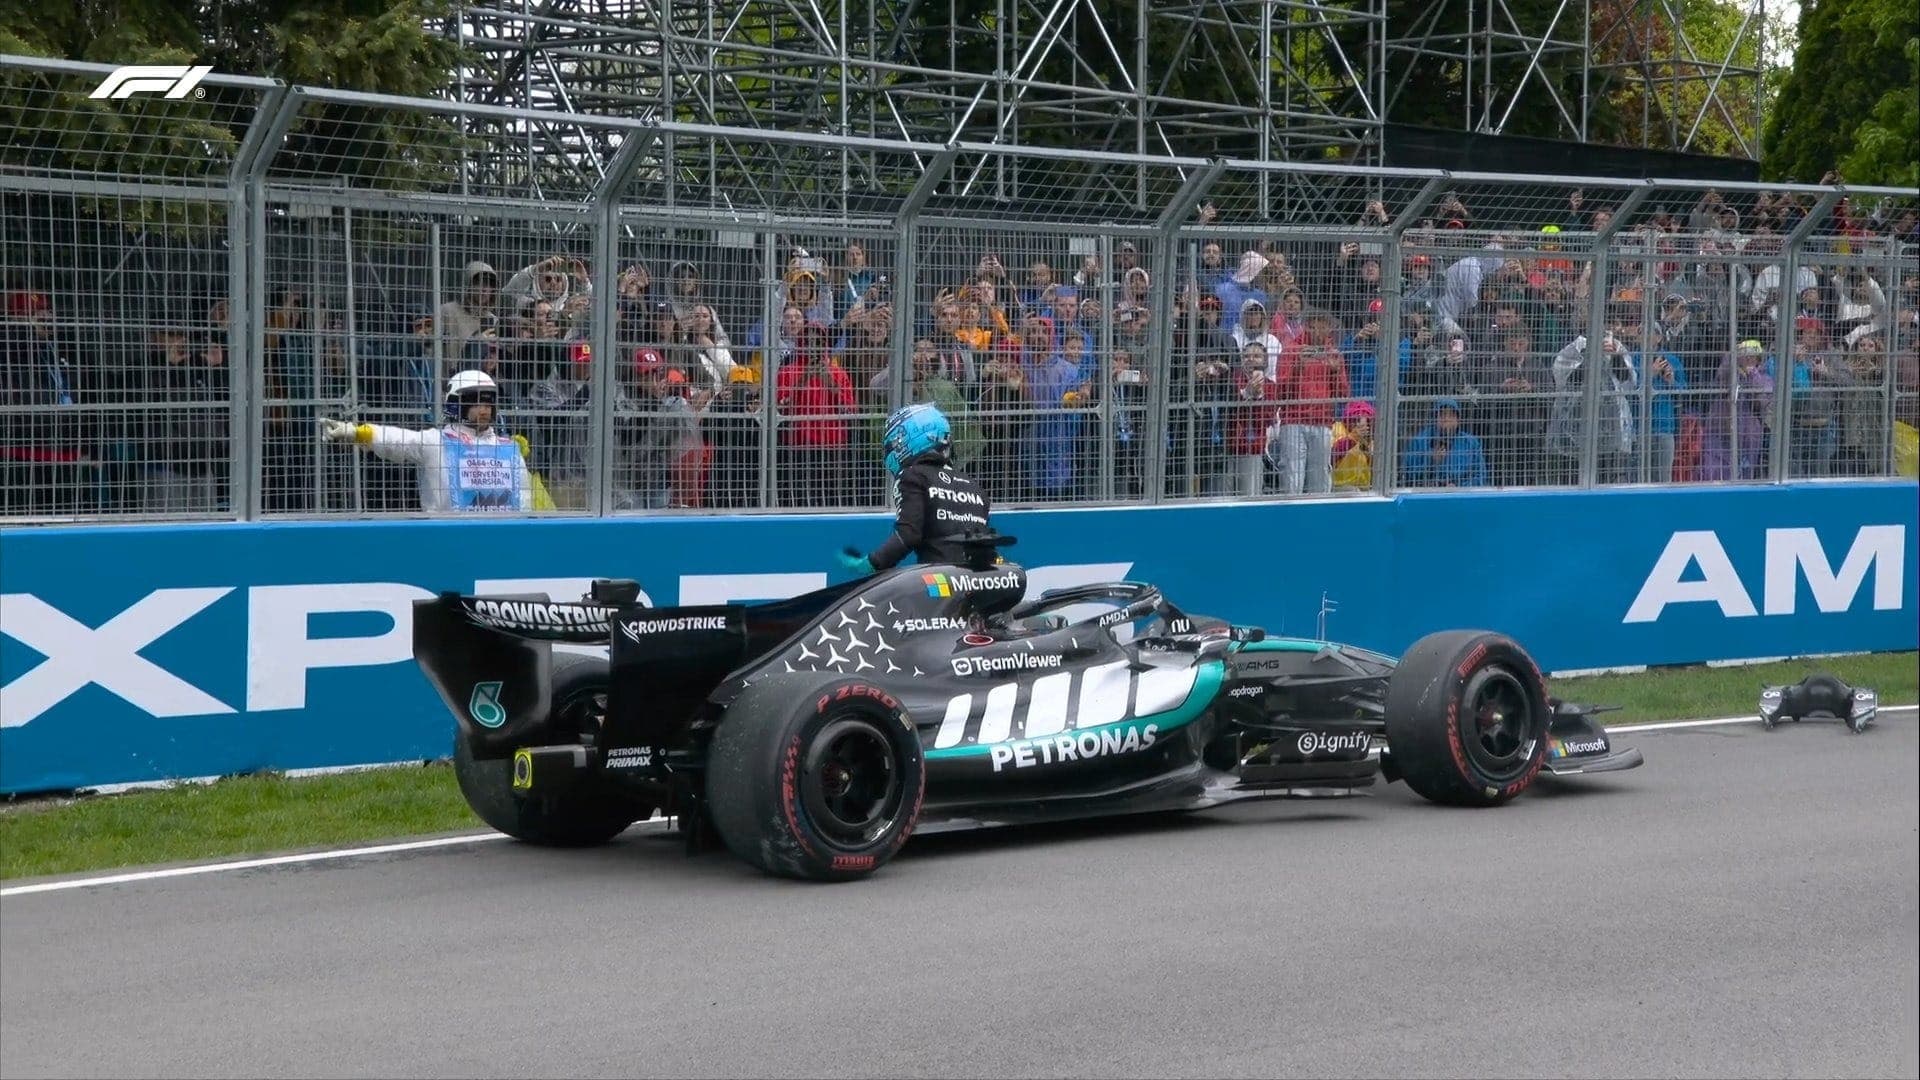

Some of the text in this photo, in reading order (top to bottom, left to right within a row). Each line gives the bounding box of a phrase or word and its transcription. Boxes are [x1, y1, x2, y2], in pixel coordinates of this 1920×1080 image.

[929, 486, 984, 506] PETRONA
[950, 571, 1020, 592] Microsoft
[629, 616, 727, 635] CROWDSTRIKE
[905, 616, 959, 631] SOLERA
[1100, 612, 1122, 628] AMD
[971, 653, 1063, 673] TeamViewer
[1246, 660, 1280, 671] AMG
[1228, 685, 1264, 698] apdragon
[608, 746, 652, 757] PETRONAS
[990, 724, 1159, 773] PETRONAS
[1564, 738, 1607, 754] Microsoft
[606, 754, 653, 769] PRIMAX
